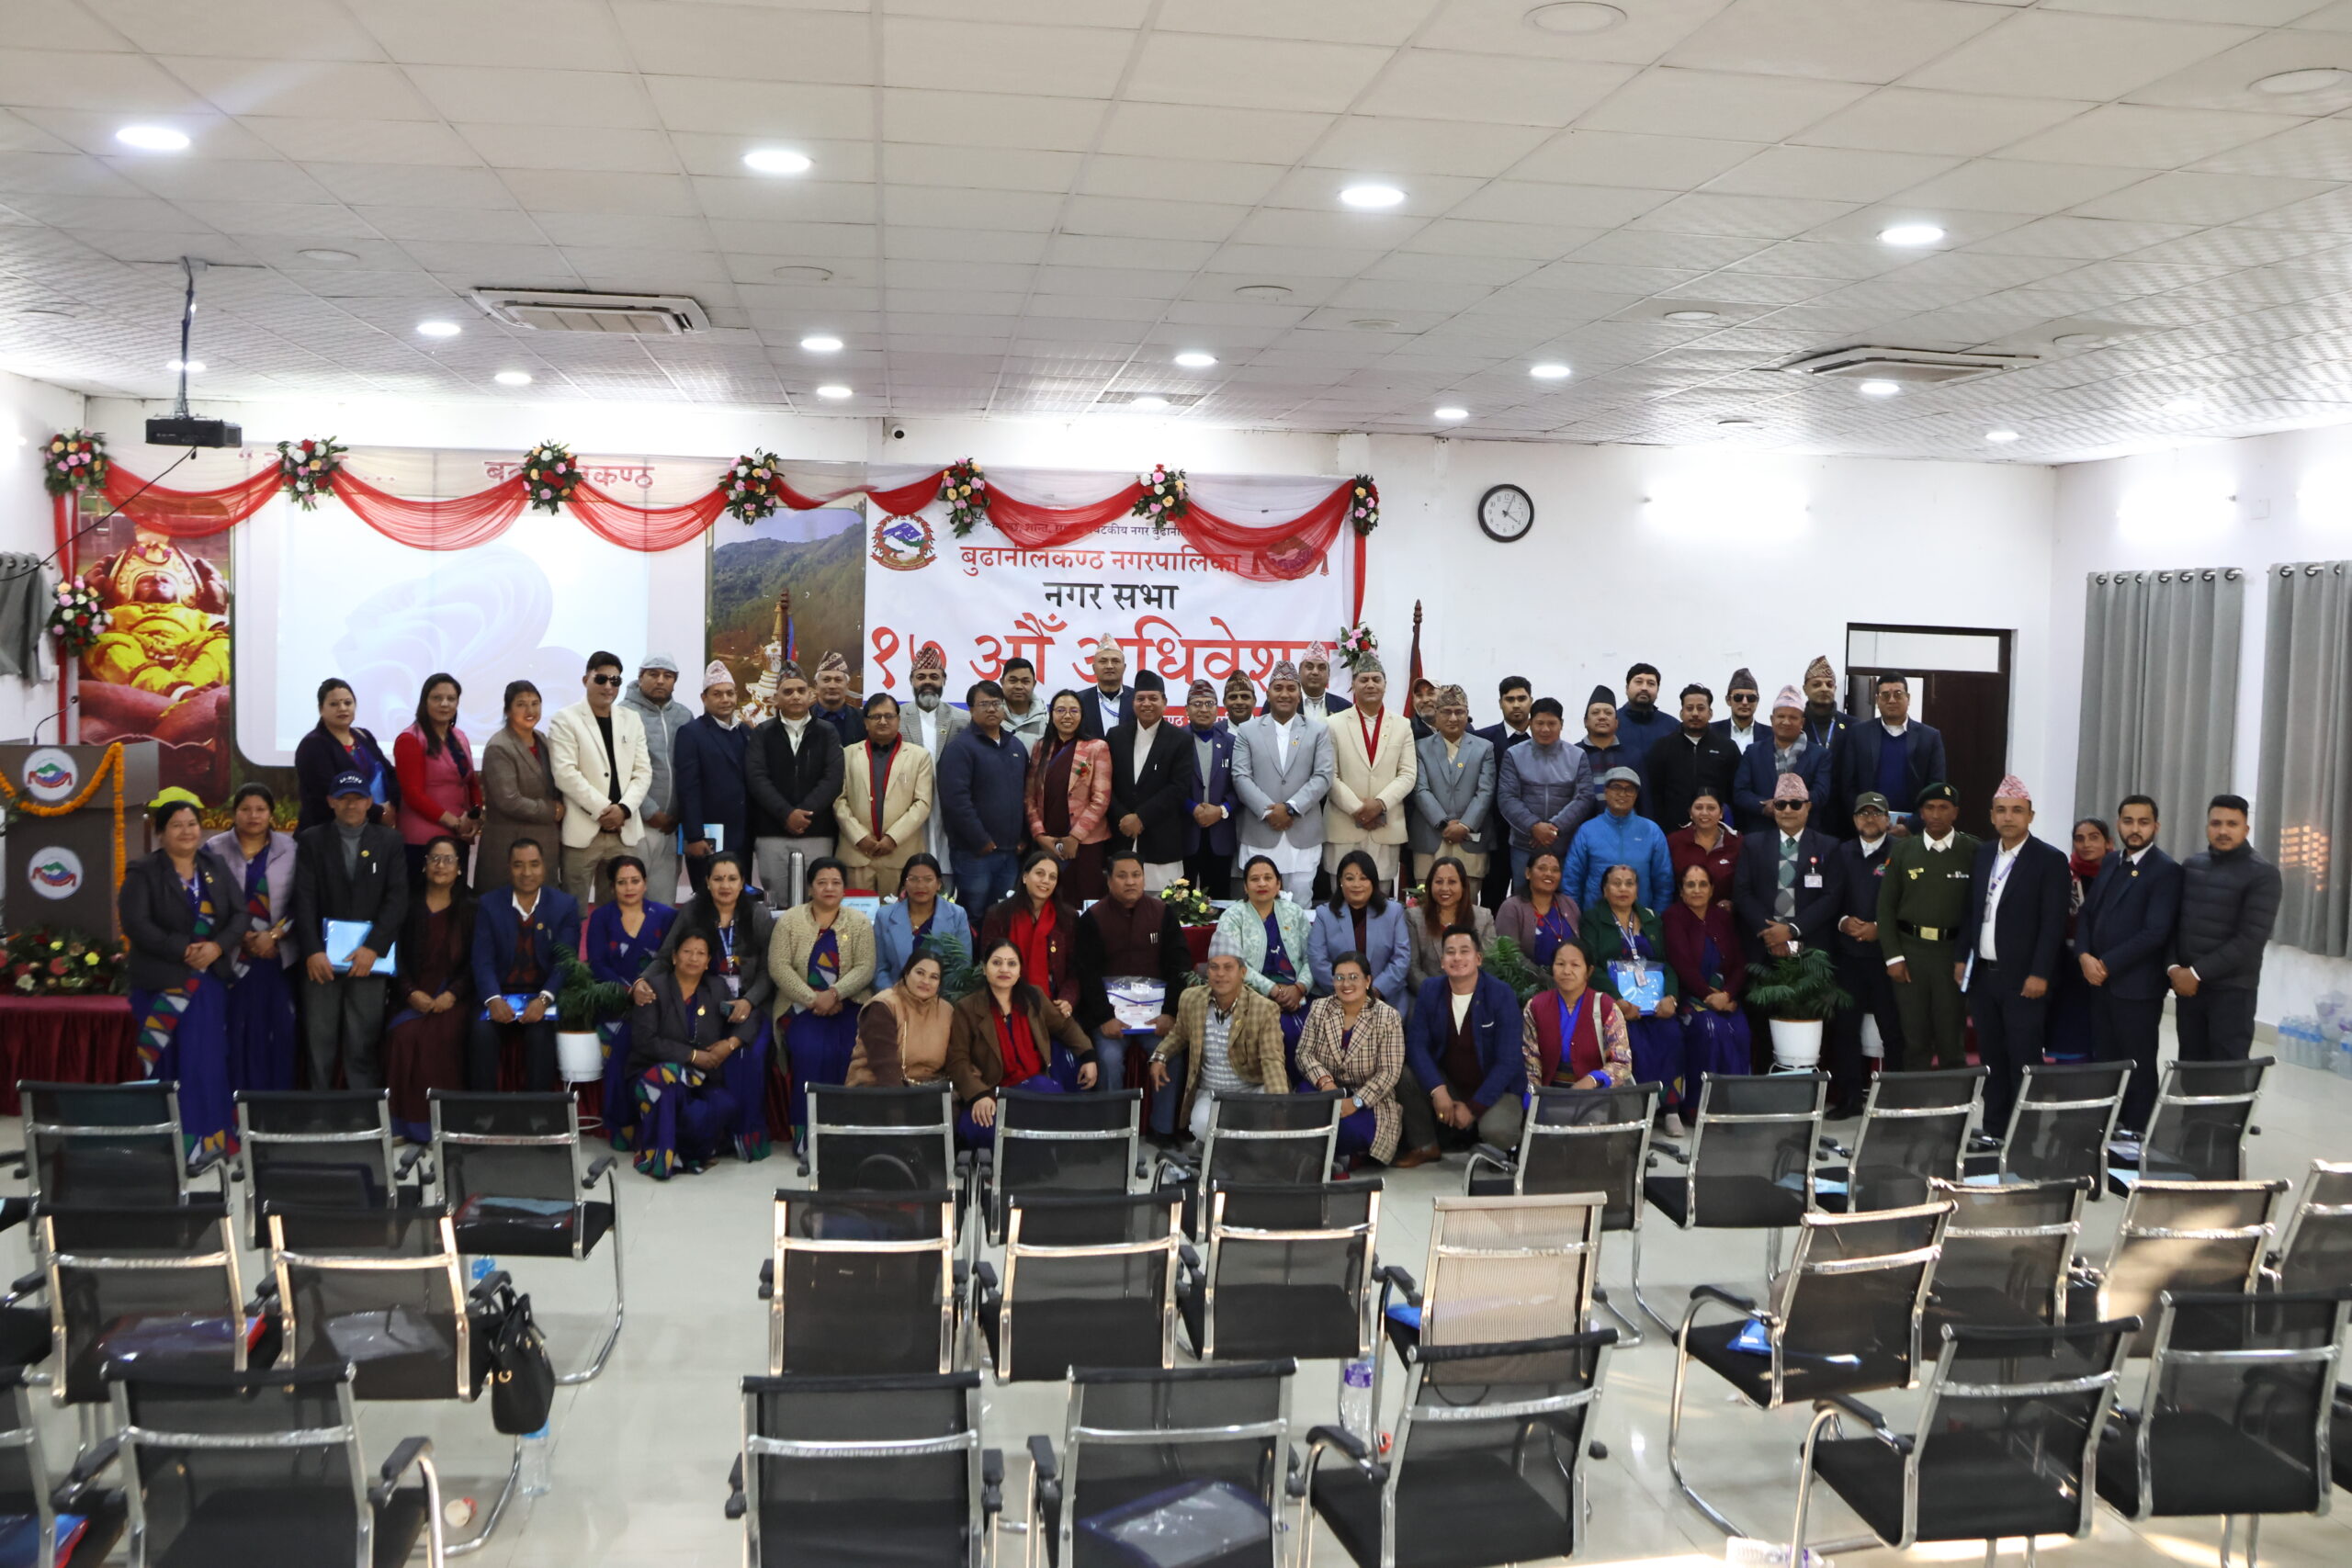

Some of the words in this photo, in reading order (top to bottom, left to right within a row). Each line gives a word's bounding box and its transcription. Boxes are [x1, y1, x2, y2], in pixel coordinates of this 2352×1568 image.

[1131, 526, 1149, 536] नगर
[1110, 543, 1243, 572] नगरपालिका
[1043, 581, 1105, 610] नगर
[1111, 583, 1180, 611] सभा
[871, 626, 947, 690] १७
